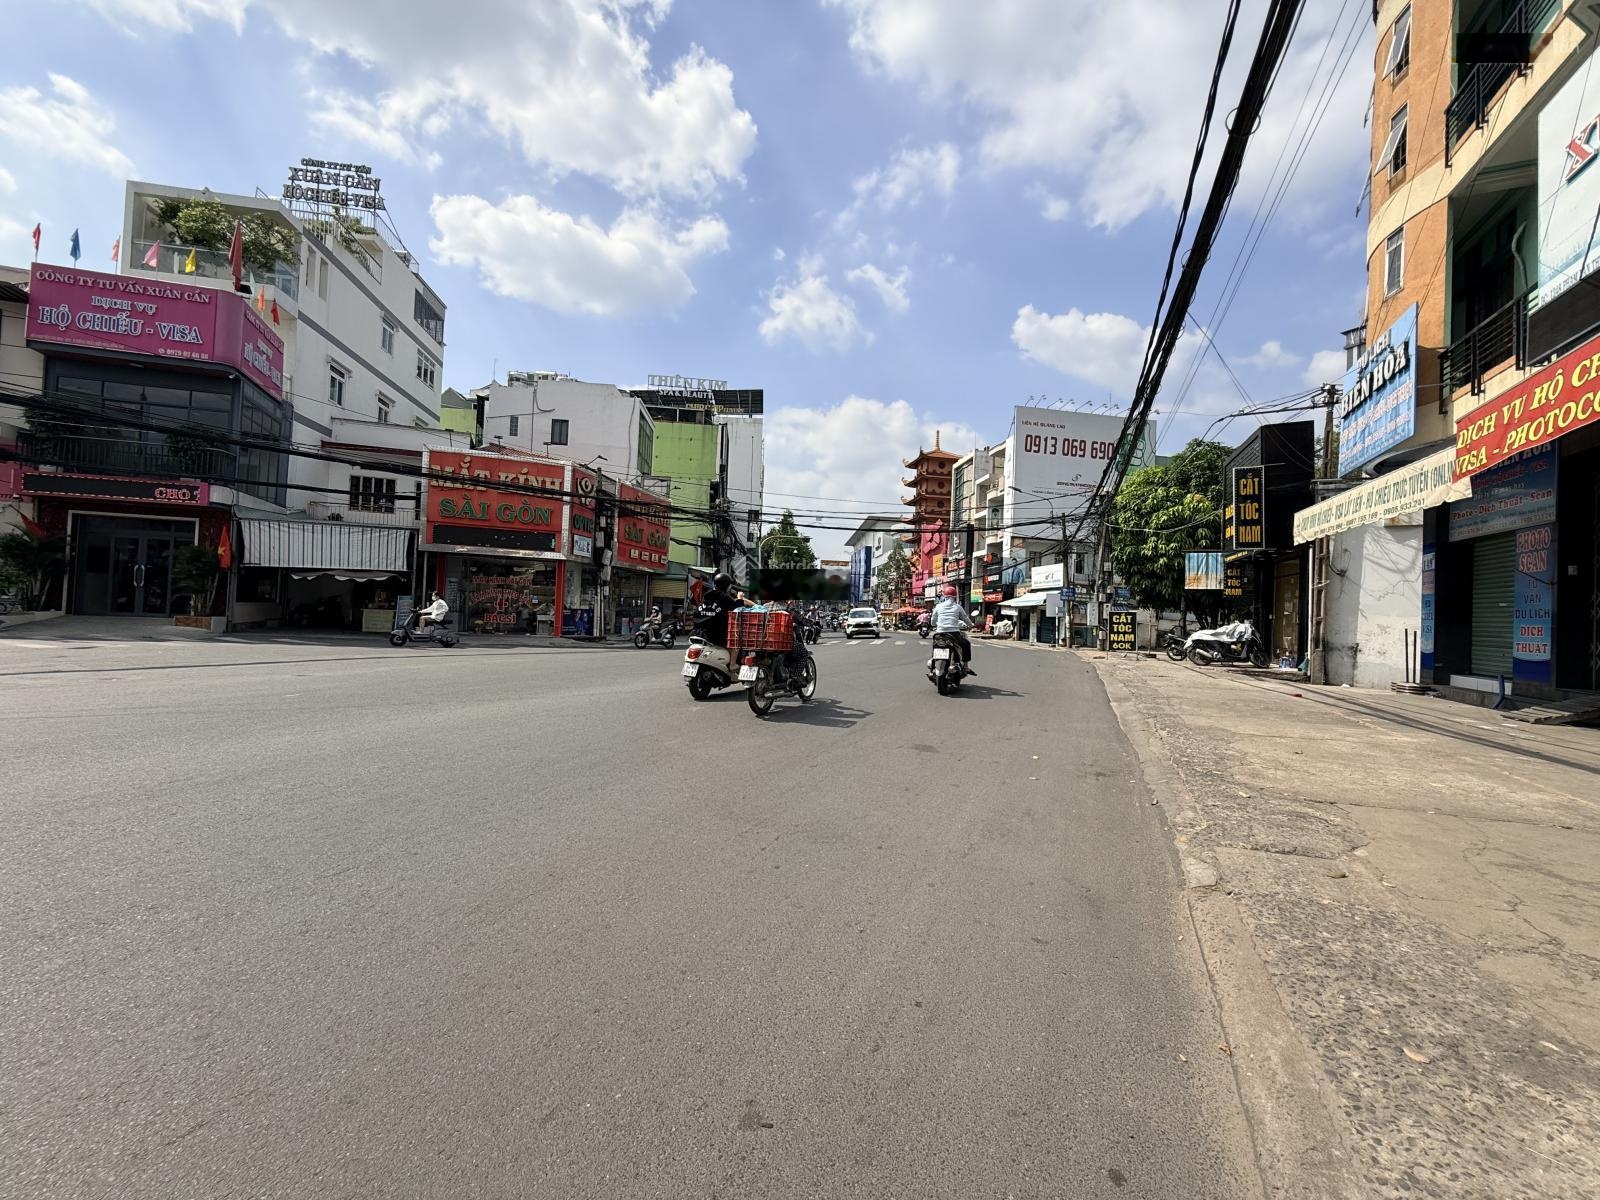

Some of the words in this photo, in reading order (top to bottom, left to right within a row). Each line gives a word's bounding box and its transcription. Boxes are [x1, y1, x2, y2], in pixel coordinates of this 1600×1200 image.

[288, 167, 341, 186] XUÂN
[351, 194, 386, 210] VISA
[36, 270, 74, 284] CÔNG
[77, 276, 96, 287] TY
[97, 279, 117, 290] TƯ
[119, 281, 144, 294] VẤN
[147, 286, 182, 299] XUÂN
[91, 295, 132, 310] DỊCH
[134, 301, 157, 315] VỤ
[38, 304, 72, 331] HỘ
[76, 311, 143, 336] CHIẾU
[155, 322, 203, 344] VISA
[648, 375, 693, 389] THIÊN
[697, 379, 728, 391] KIM
[1456, 412, 1498, 449] DỊCH
[1502, 394, 1527, 424] VỤ
[1530, 368, 1564, 410] HỘ
[1024, 434, 1058, 455] 0913
[1062, 438, 1087, 458] 069
[1090, 441, 1115, 460] 690
[1455, 446, 1488, 476] VISA
[498, 467, 562, 499] KÍNH
[1239, 473, 1260, 496] CẮT
[440, 494, 489, 520] SÀI
[497, 499, 552, 525] GÒN
[1239, 500, 1259, 520] TÓC
[1453, 509, 1473, 520] Photo
[1530, 489, 1552, 501] Scan
[1239, 526, 1261, 542] NAM
[1517, 528, 1551, 552] PHOTO
[1520, 551, 1547, 572] SCAN
[1112, 612, 1133, 623] CẮT
[1515, 609, 1527, 619] DU
[1110, 633, 1135, 641] NAM
[1112, 623, 1132, 632] TÓC
